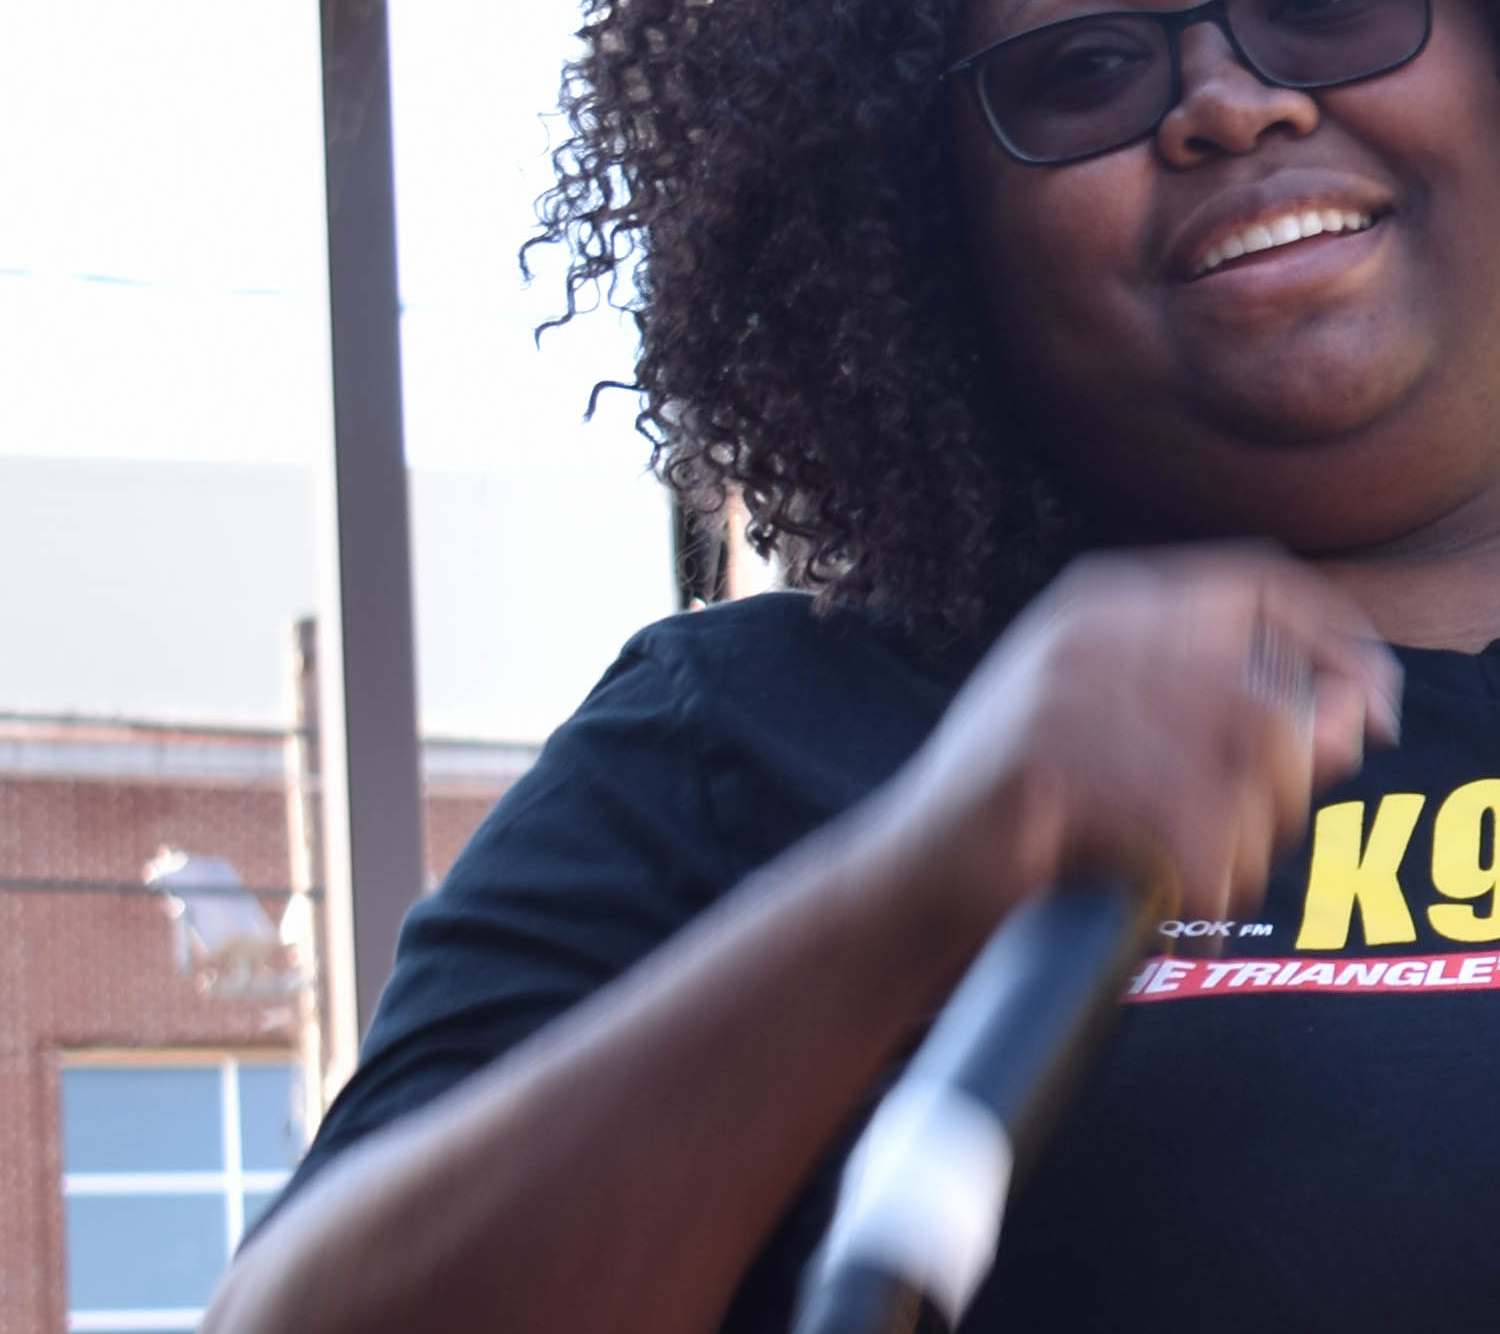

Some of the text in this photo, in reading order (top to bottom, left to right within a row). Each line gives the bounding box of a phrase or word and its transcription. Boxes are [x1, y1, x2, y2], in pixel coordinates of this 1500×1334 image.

[1158, 920, 1274, 938] QOK FM
[1124, 960, 1196, 995] HE
